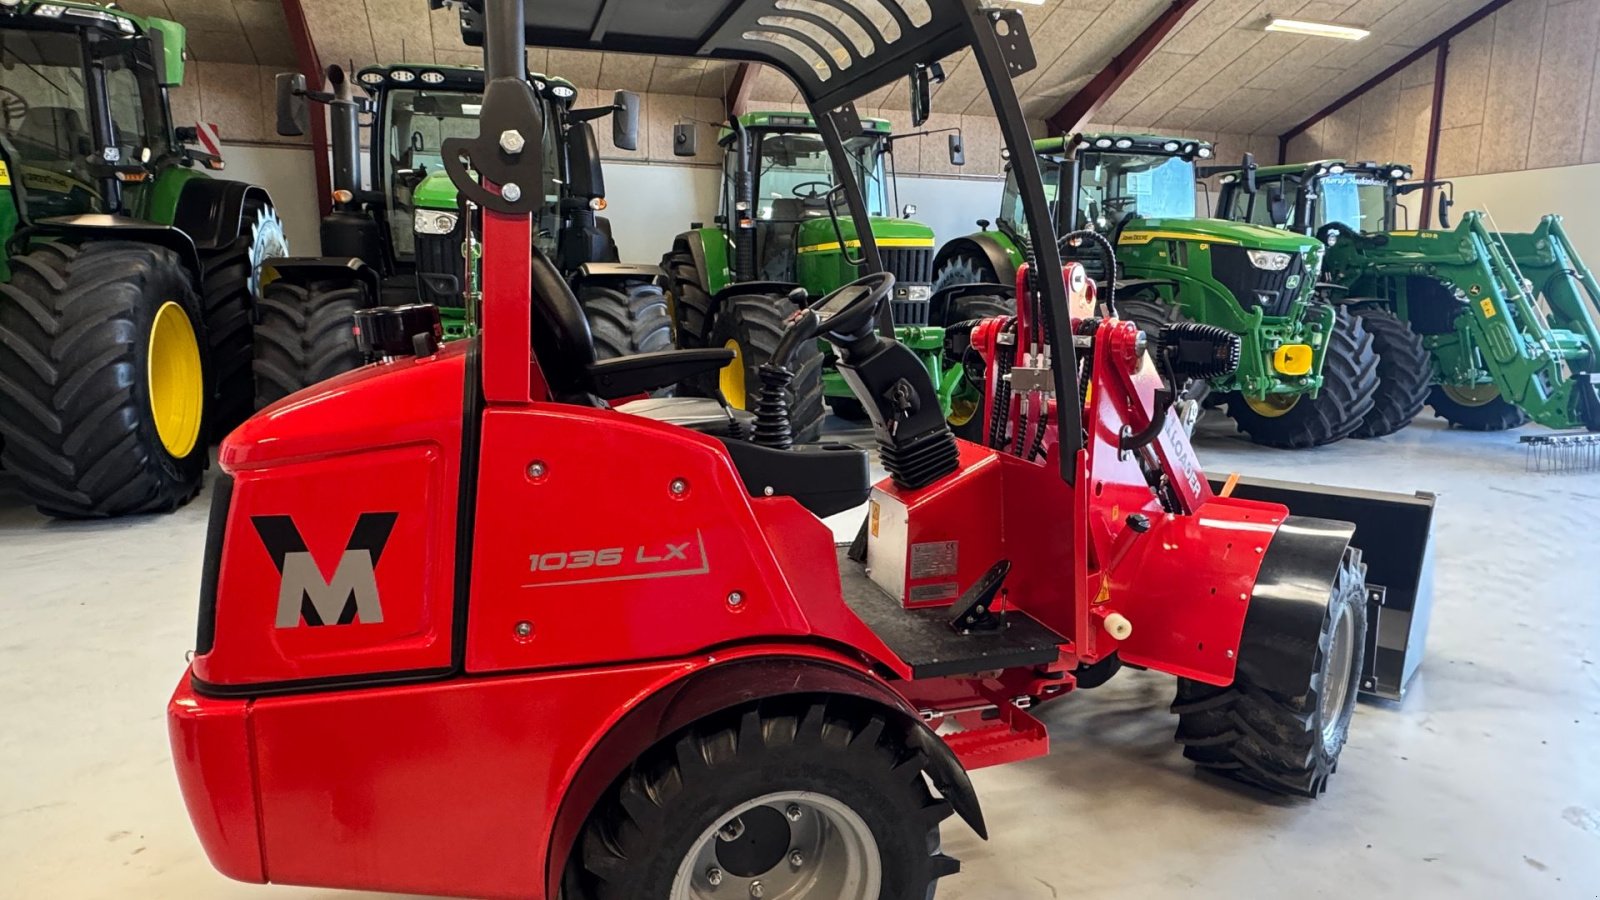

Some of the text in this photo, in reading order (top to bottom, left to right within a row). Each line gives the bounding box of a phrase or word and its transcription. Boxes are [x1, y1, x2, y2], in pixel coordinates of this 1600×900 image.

[1170, 429, 1202, 500] LOADER
[529, 541, 691, 572] 1036 LX
